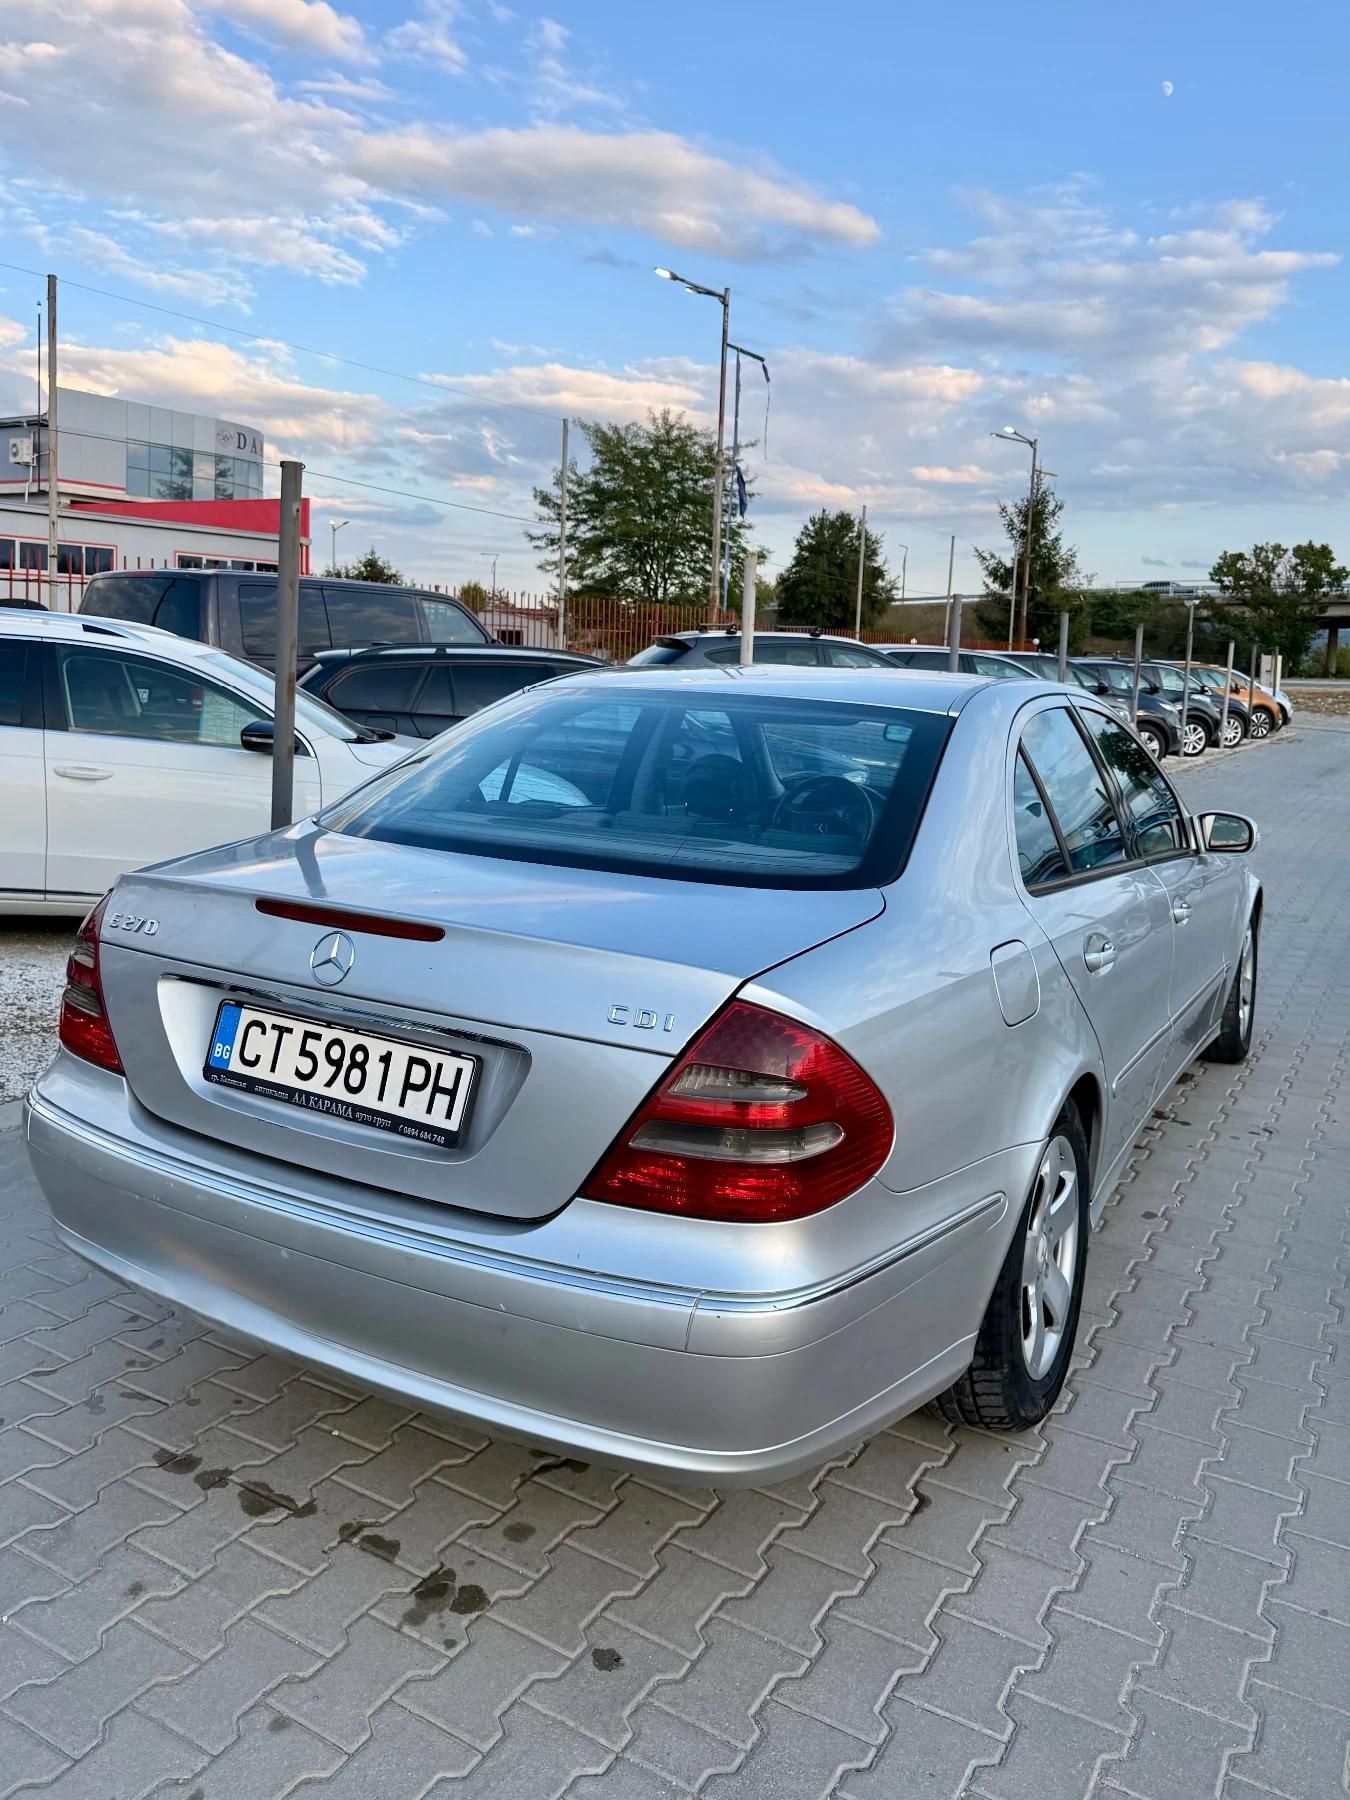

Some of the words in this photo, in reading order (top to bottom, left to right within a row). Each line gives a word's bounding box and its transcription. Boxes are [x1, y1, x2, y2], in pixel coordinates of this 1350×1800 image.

[607, 1004, 675, 1032] CDI
[214, 1043, 231, 1060] BG
[308, 1095, 353, 1119] КАРАМА
[355, 1111, 372, 1122] ауто
[373, 1116, 392, 1129] груп
